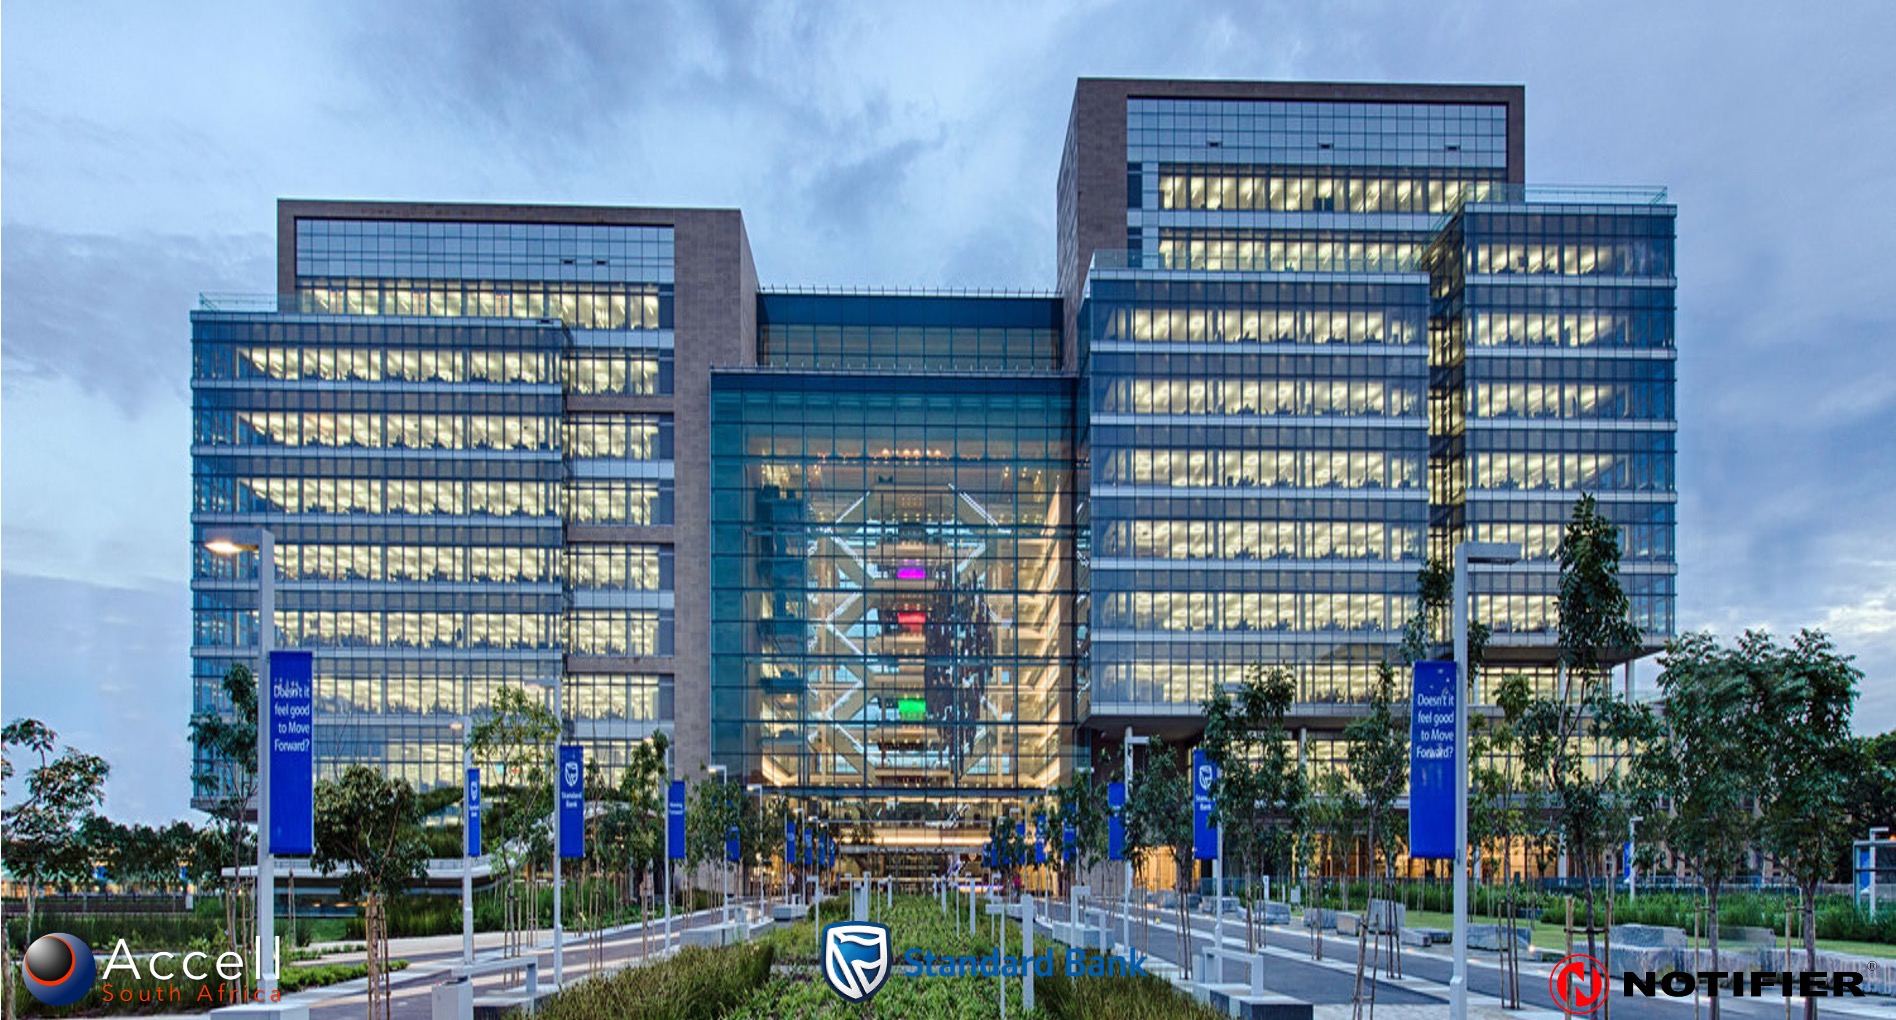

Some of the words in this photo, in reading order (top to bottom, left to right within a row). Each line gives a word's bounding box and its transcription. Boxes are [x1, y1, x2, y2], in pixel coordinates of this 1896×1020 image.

[1417, 693, 1447, 707] Doesn't
[1448, 694, 1455, 707] it
[274, 702, 289, 717] feel
[290, 702, 310, 719] good
[1417, 709, 1432, 724] feel
[1433, 710, 1455, 727] good
[278, 722, 287, 734] to
[288, 721, 310, 734] Move
[1420, 730, 1430, 742] to
[1430, 728, 1455, 741] Move
[274, 738, 310, 752] Forward?
[1416, 745, 1454, 759] Forward?
